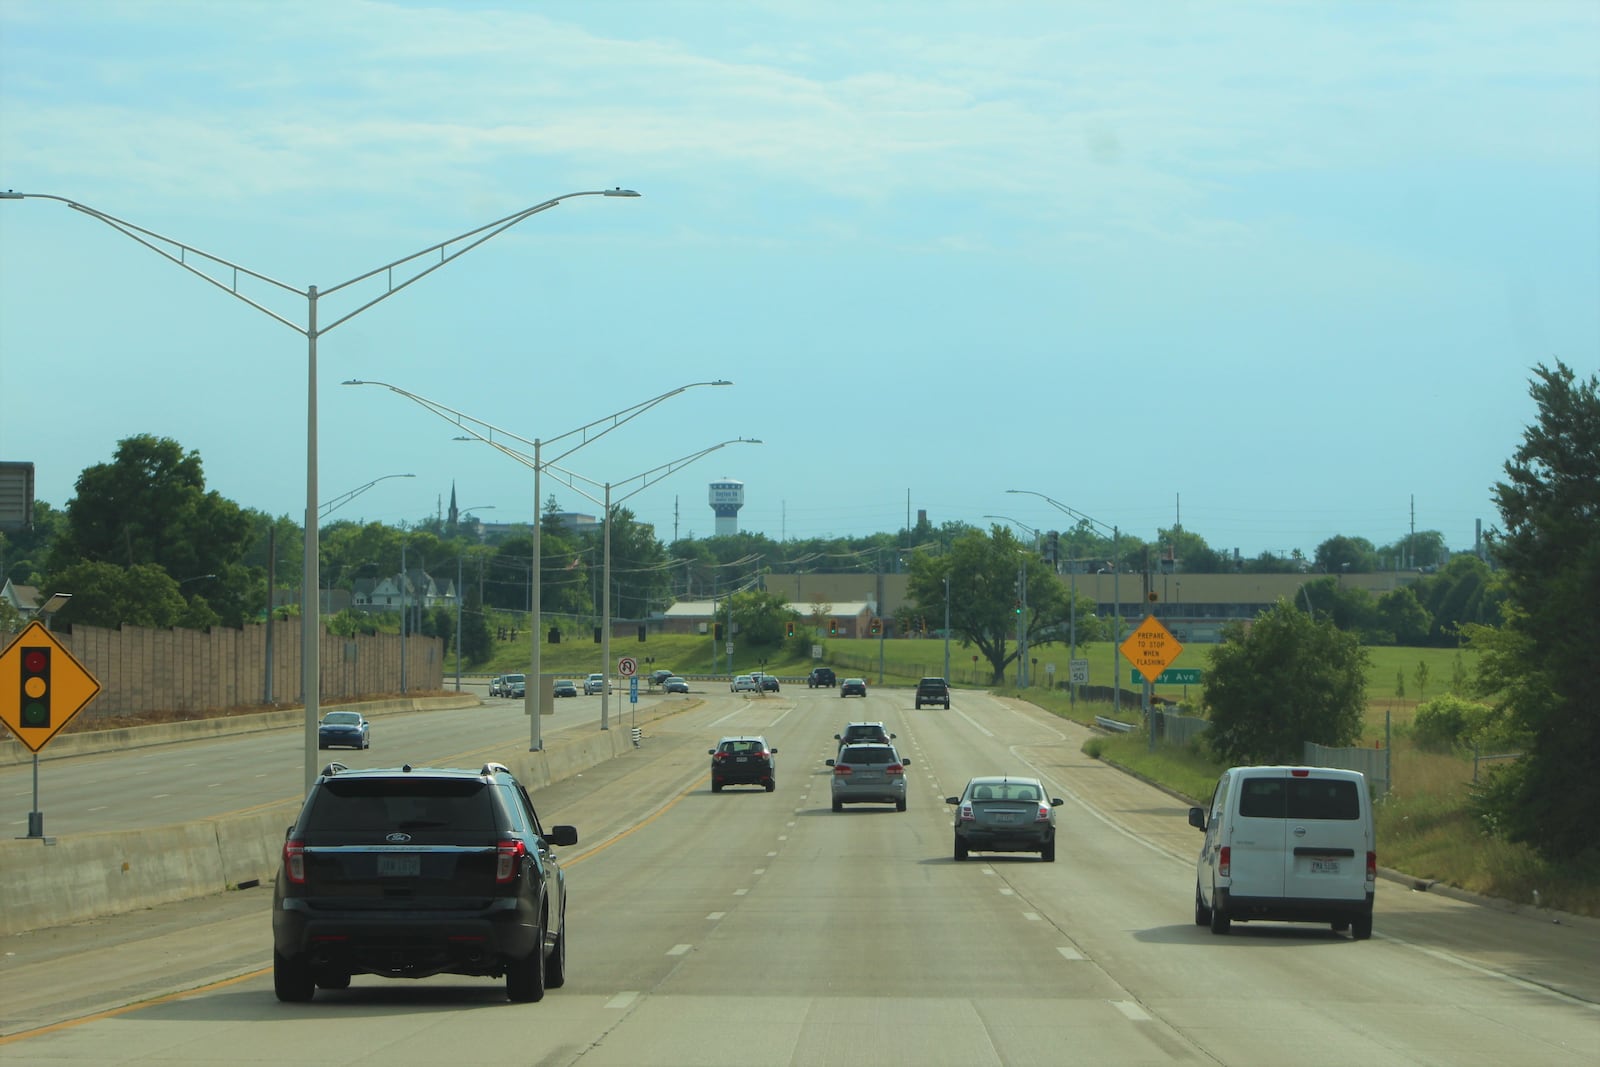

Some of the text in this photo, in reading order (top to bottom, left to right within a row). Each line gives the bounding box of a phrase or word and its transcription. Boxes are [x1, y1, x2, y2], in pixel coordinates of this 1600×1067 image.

[1136, 658, 1165, 666] FLASHING
[1073, 673, 1085, 681] 50
[1175, 673, 1194, 681] Ave
